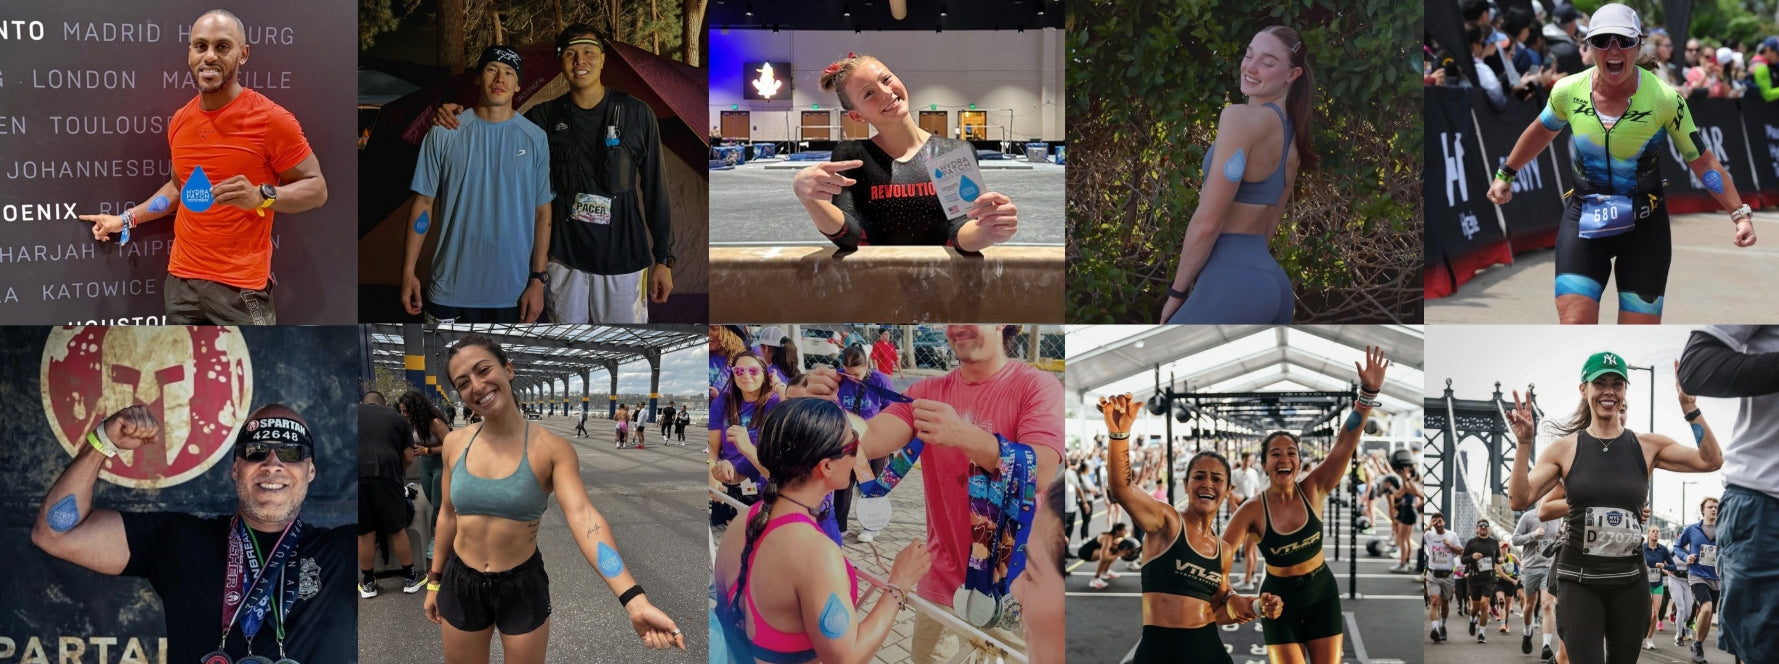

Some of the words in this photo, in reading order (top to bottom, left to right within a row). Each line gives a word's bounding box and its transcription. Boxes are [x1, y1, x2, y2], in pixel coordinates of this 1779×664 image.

[63, 21, 161, 43] MADRID
[178, 23, 294, 46] HURG
[32, 69, 136, 90] LONDON
[941, 156, 969, 171] HYDRA
[943, 161, 971, 177] PATCH
[3, 202, 78, 222] OENIX
[576, 201, 606, 216] PACER
[1594, 206, 1619, 222] 580
[42, 278, 156, 301] KATOWICE
[260, 418, 306, 436] SPARTAN
[252, 430, 299, 442] 42648
